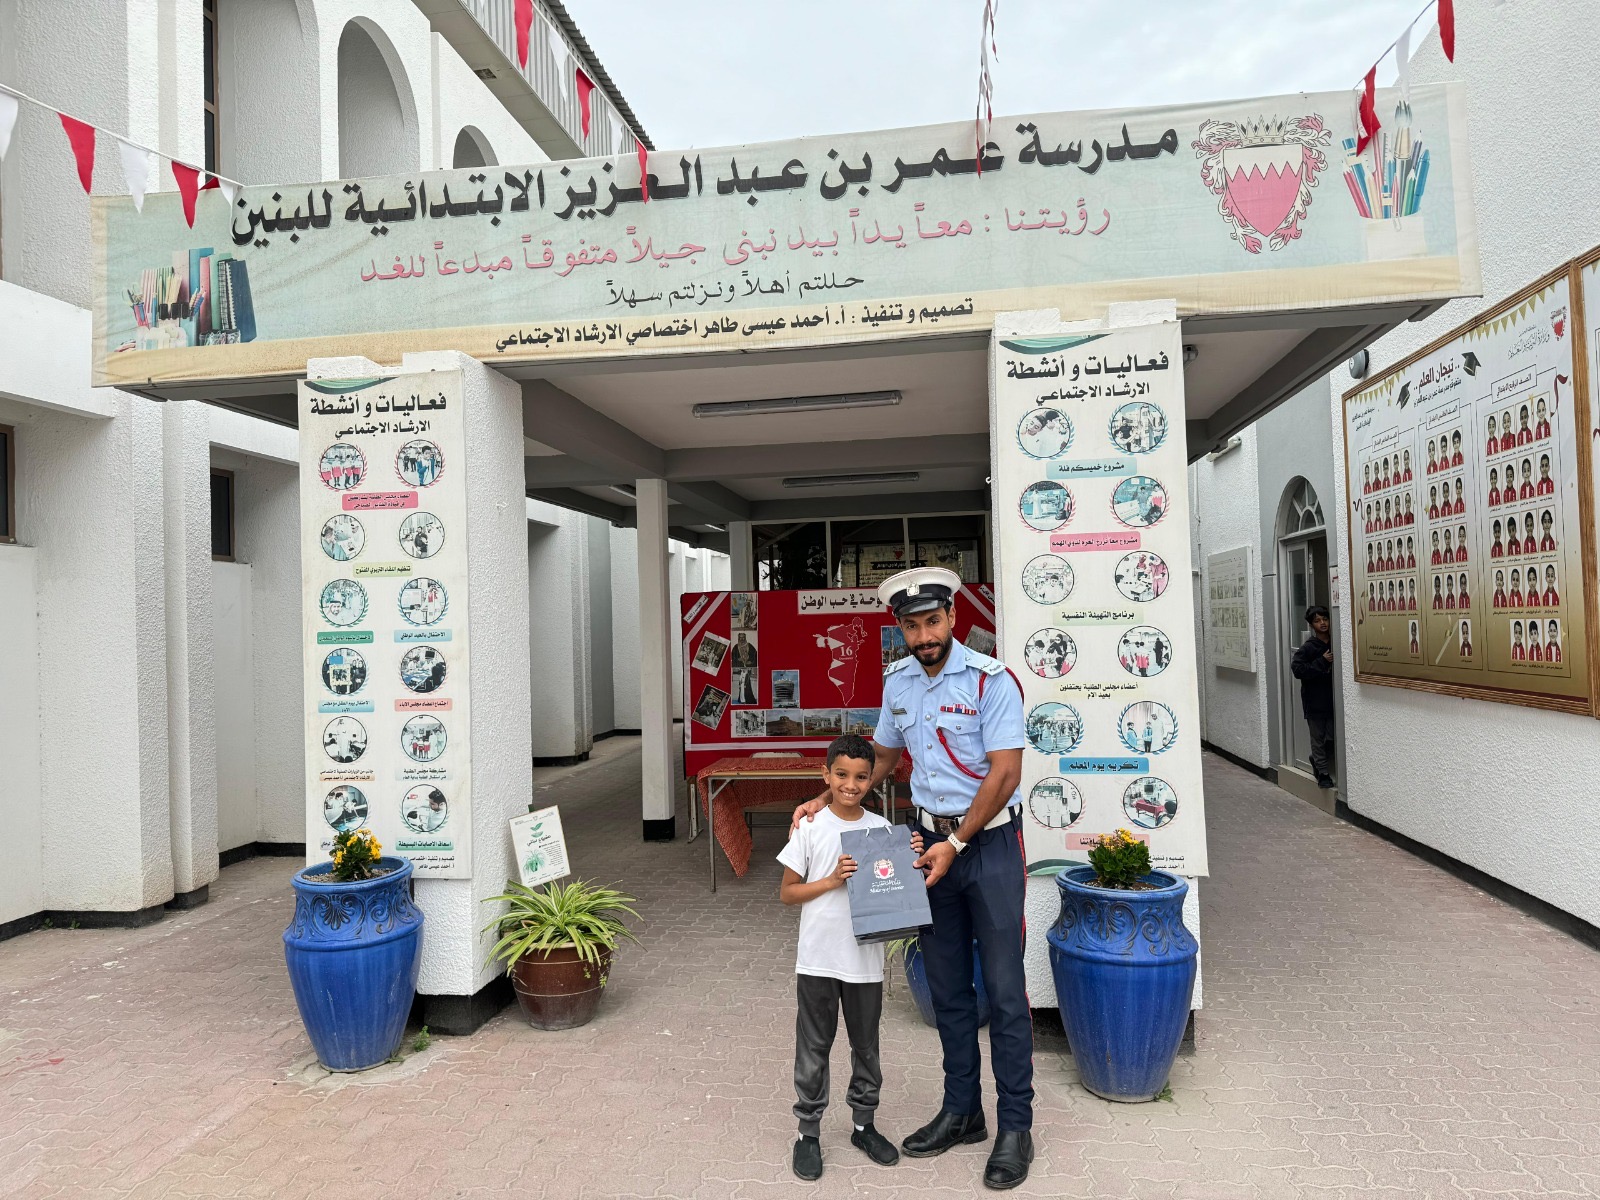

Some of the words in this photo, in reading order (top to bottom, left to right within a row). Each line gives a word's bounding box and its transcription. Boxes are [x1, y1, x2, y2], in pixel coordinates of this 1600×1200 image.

[1015, 122, 1178, 175] مدرسة
[819, 148, 873, 200] بن
[880, 141, 1005, 193] عمر
[553, 153, 702, 221] العزيز
[716, 156, 808, 206] عبد
[344, 168, 546, 236] الابتدائية
[231, 188, 334, 248] للبنين
[915, 201, 972, 239] معاً
[1004, 197, 1111, 235] رؤيتنا
[626, 225, 705, 269] جيلاً
[788, 226, 839, 256] بيد
[360, 254, 425, 282] للغد
[433, 241, 512, 279] مبدعاً
[606, 279, 662, 309] سهلاً
[740, 270, 790, 297] أهلاً
[799, 271, 864, 299] حللتم
[791, 306, 829, 328] أحمد
[919, 297, 973, 323] تصميم
[574, 323, 621, 344] الارشاد
[626, 318, 697, 346] اختصاصي
[701, 316, 738, 338] طاهر
[741, 316, 786, 336] عيسى
[495, 326, 570, 352] الاجتماعي
[1006, 354, 1065, 380] أنشطة
[1085, 350, 1169, 379] فعاليات
[1436, 357, 1454, 383] تيجان
[1105, 381, 1150, 398] الارشاد
[1419, 366, 1434, 394] العلم
[310, 393, 359, 415] أنشطة
[376, 392, 447, 417] فعاليات
[1035, 385, 1101, 406] الاجتماعي
[335, 422, 390, 440] الاجتماعي
[393, 420, 430, 435] الارشاد
[1071, 464, 1102, 473] خميسكم
[1104, 462, 1125, 472] مشروع
[1120, 536, 1138, 545] مشروع
[801, 595, 827, 610] الوطن
[829, 597, 848, 609] حب
[850, 594, 858, 608] في
[860, 593, 883, 608] وحة
[1062, 611, 1087, 621] النفسية
[1112, 610, 1135, 620] برنامج
[840, 646, 853, 657] 16
[1102, 683, 1120, 691] مجلس
[1069, 761, 1090, 771] المعلم
[1092, 763, 1105, 772] يوم
[1108, 760, 1139, 771] تكريم
